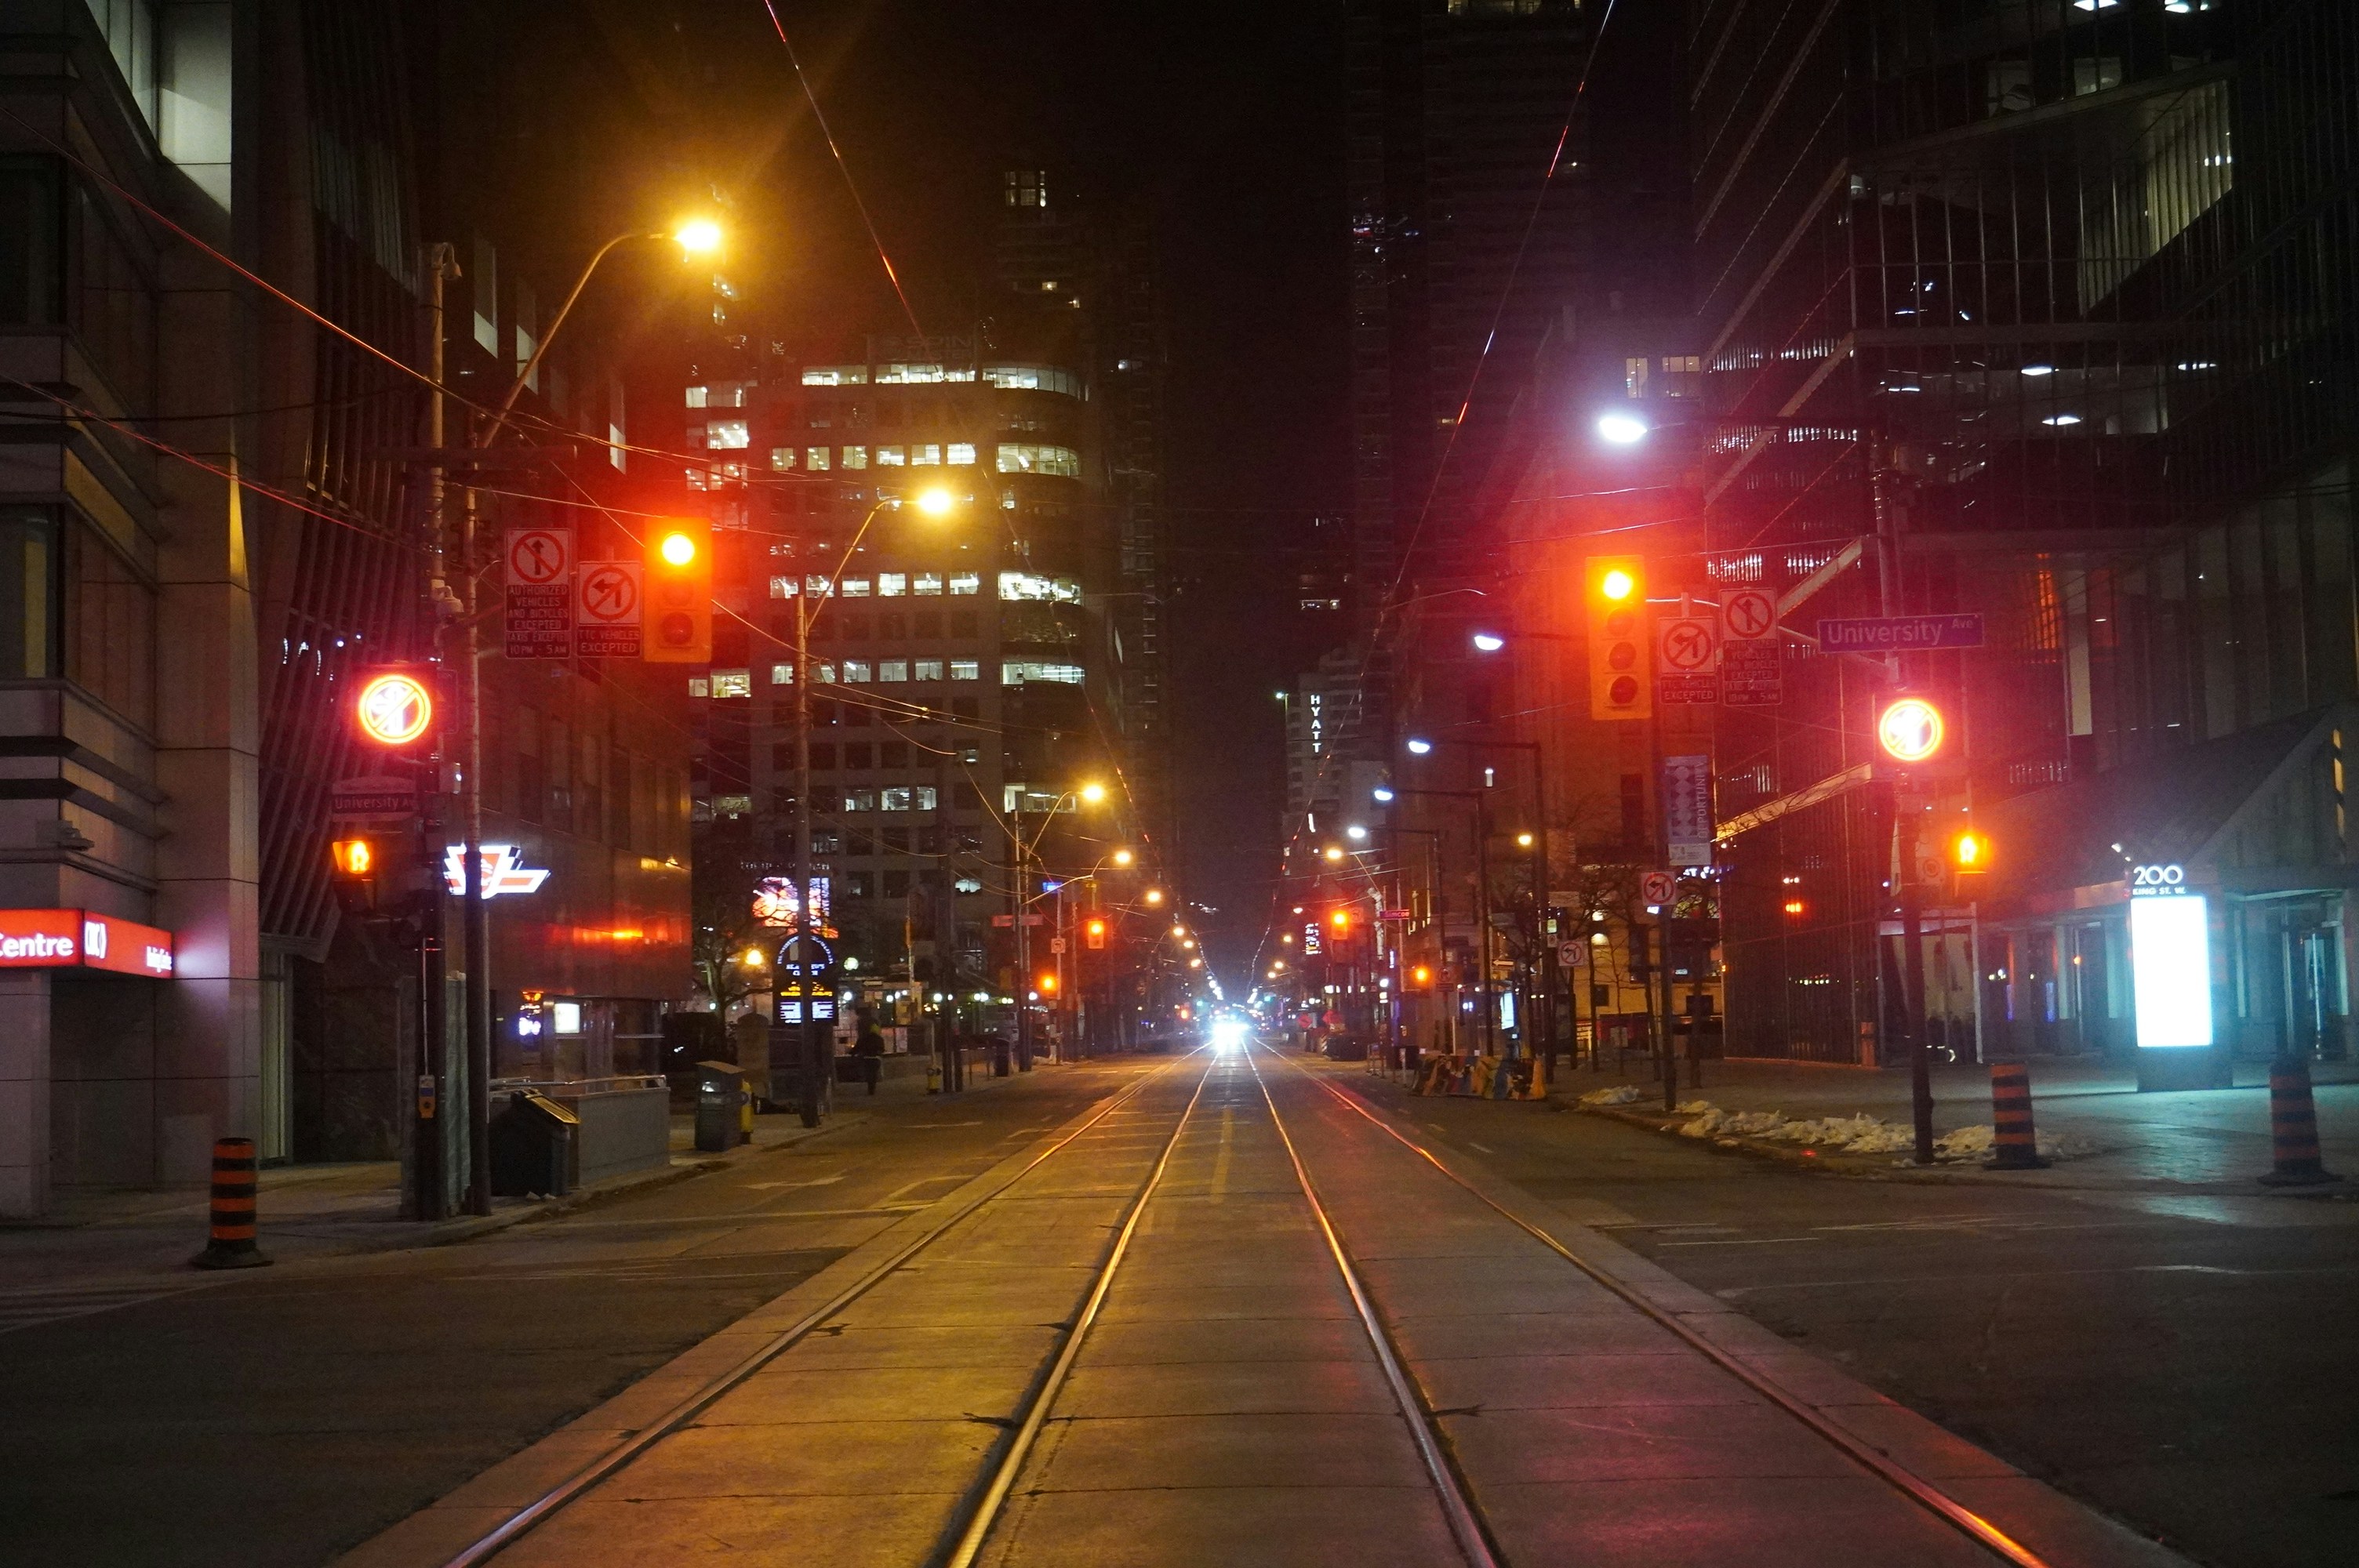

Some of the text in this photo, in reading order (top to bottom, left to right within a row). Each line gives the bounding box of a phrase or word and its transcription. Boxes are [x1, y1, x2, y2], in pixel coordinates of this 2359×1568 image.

[509, 586, 567, 595] AUTHORIZED
[516, 597, 561, 607] VEHICLES
[508, 608, 568, 618] AND BICYCLES
[514, 619, 562, 630] EXCEPTED
[1827, 619, 1973, 645] University Ave
[581, 642, 637, 652] EXCEPTED
[1664, 690, 1714, 700] EXCEPTED
[1310, 695, 1321, 753] HYATT
[335, 797, 398, 811] University
[2133, 866, 2183, 885] 200
[0, 933, 74, 957] entre
